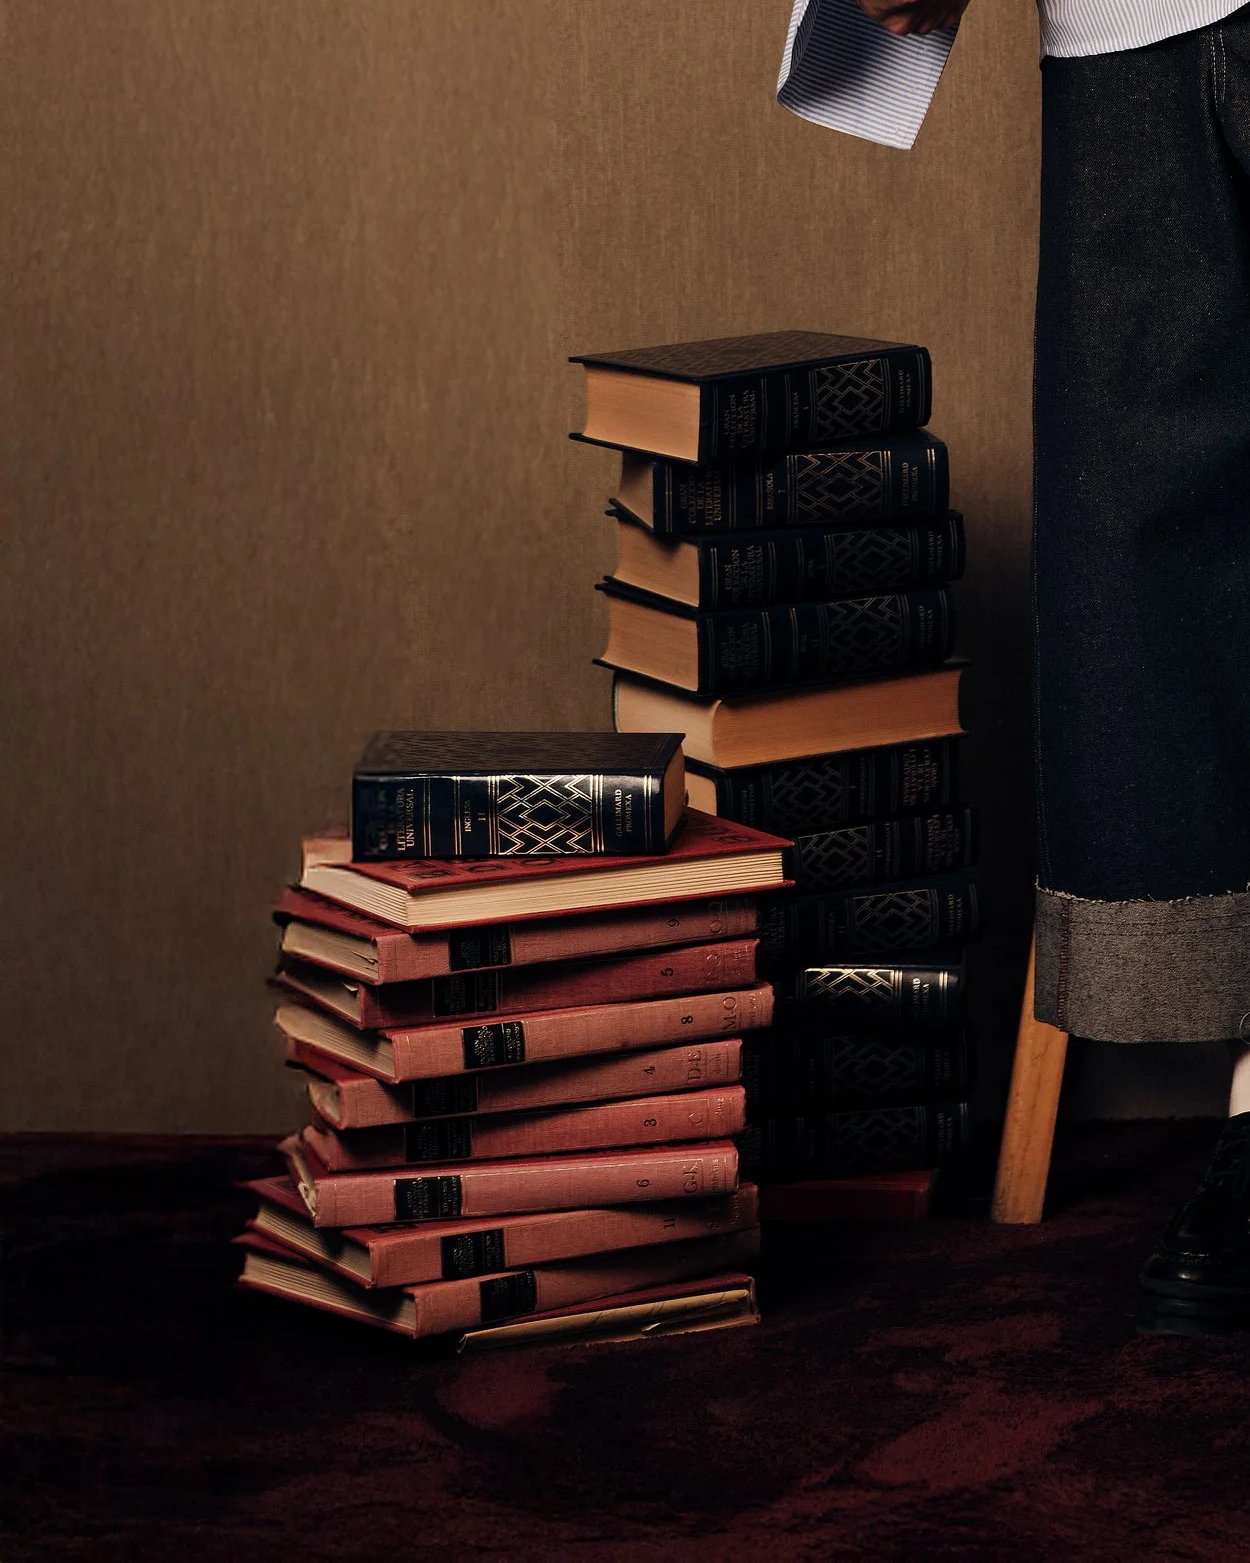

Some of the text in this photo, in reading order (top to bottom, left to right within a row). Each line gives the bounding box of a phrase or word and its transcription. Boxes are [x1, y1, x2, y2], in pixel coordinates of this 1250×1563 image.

[679, 483, 687, 509] GRAN
[697, 481, 705, 509] DE LA
[395, 786, 406, 851] LITERATURA
[614, 788, 623, 837] GALLIMARD
[624, 793, 633, 833] PROMEXA
[668, 919, 680, 927] 9
[661, 967, 674, 978] 5
[681, 1015, 693, 1025] 8
[642, 1066, 655, 1075] 4
[687, 1051, 702, 1080] D-E
[644, 1118, 657, 1127] 3
[636, 1179, 650, 1188] 6
[664, 1217, 676, 1229] 11
